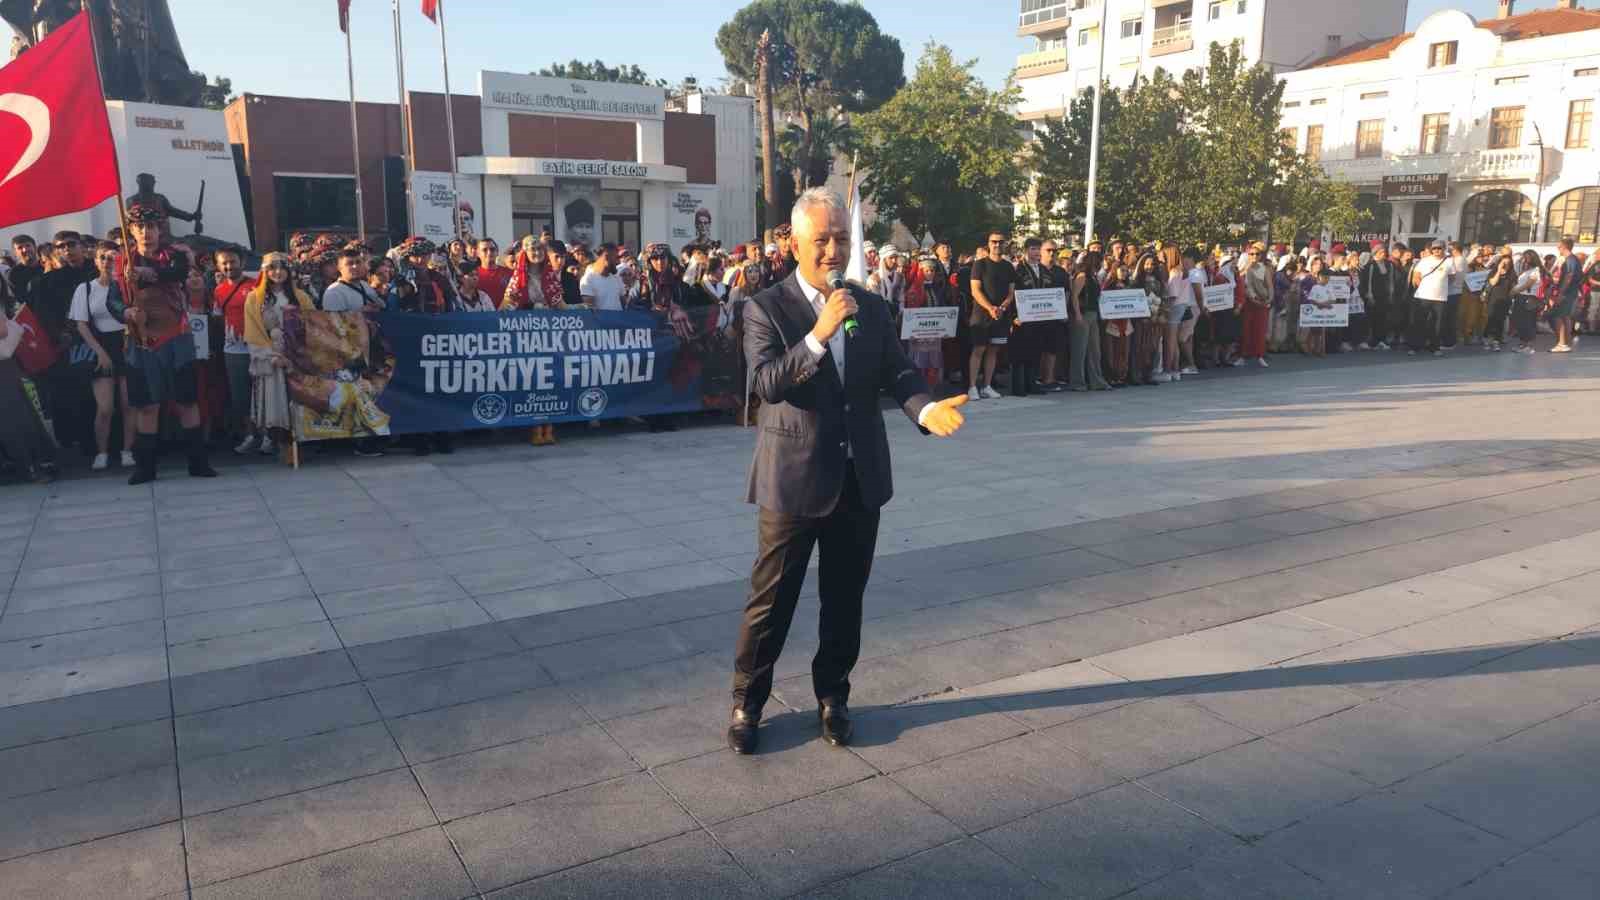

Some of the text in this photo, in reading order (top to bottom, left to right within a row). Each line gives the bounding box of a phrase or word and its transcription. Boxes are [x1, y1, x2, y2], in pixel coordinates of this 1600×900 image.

[577, 162, 608, 175] SERGİ
[612, 164, 648, 177] SALONU
[1400, 185, 1424, 193] OTEL
[499, 314, 584, 331] MANİSA 2026
[421, 327, 653, 359] GENÇLER HALK OYUNLARI
[420, 351, 655, 393] TÜRKİYE FİNALİ
[514, 401, 569, 413] DUTLULU
